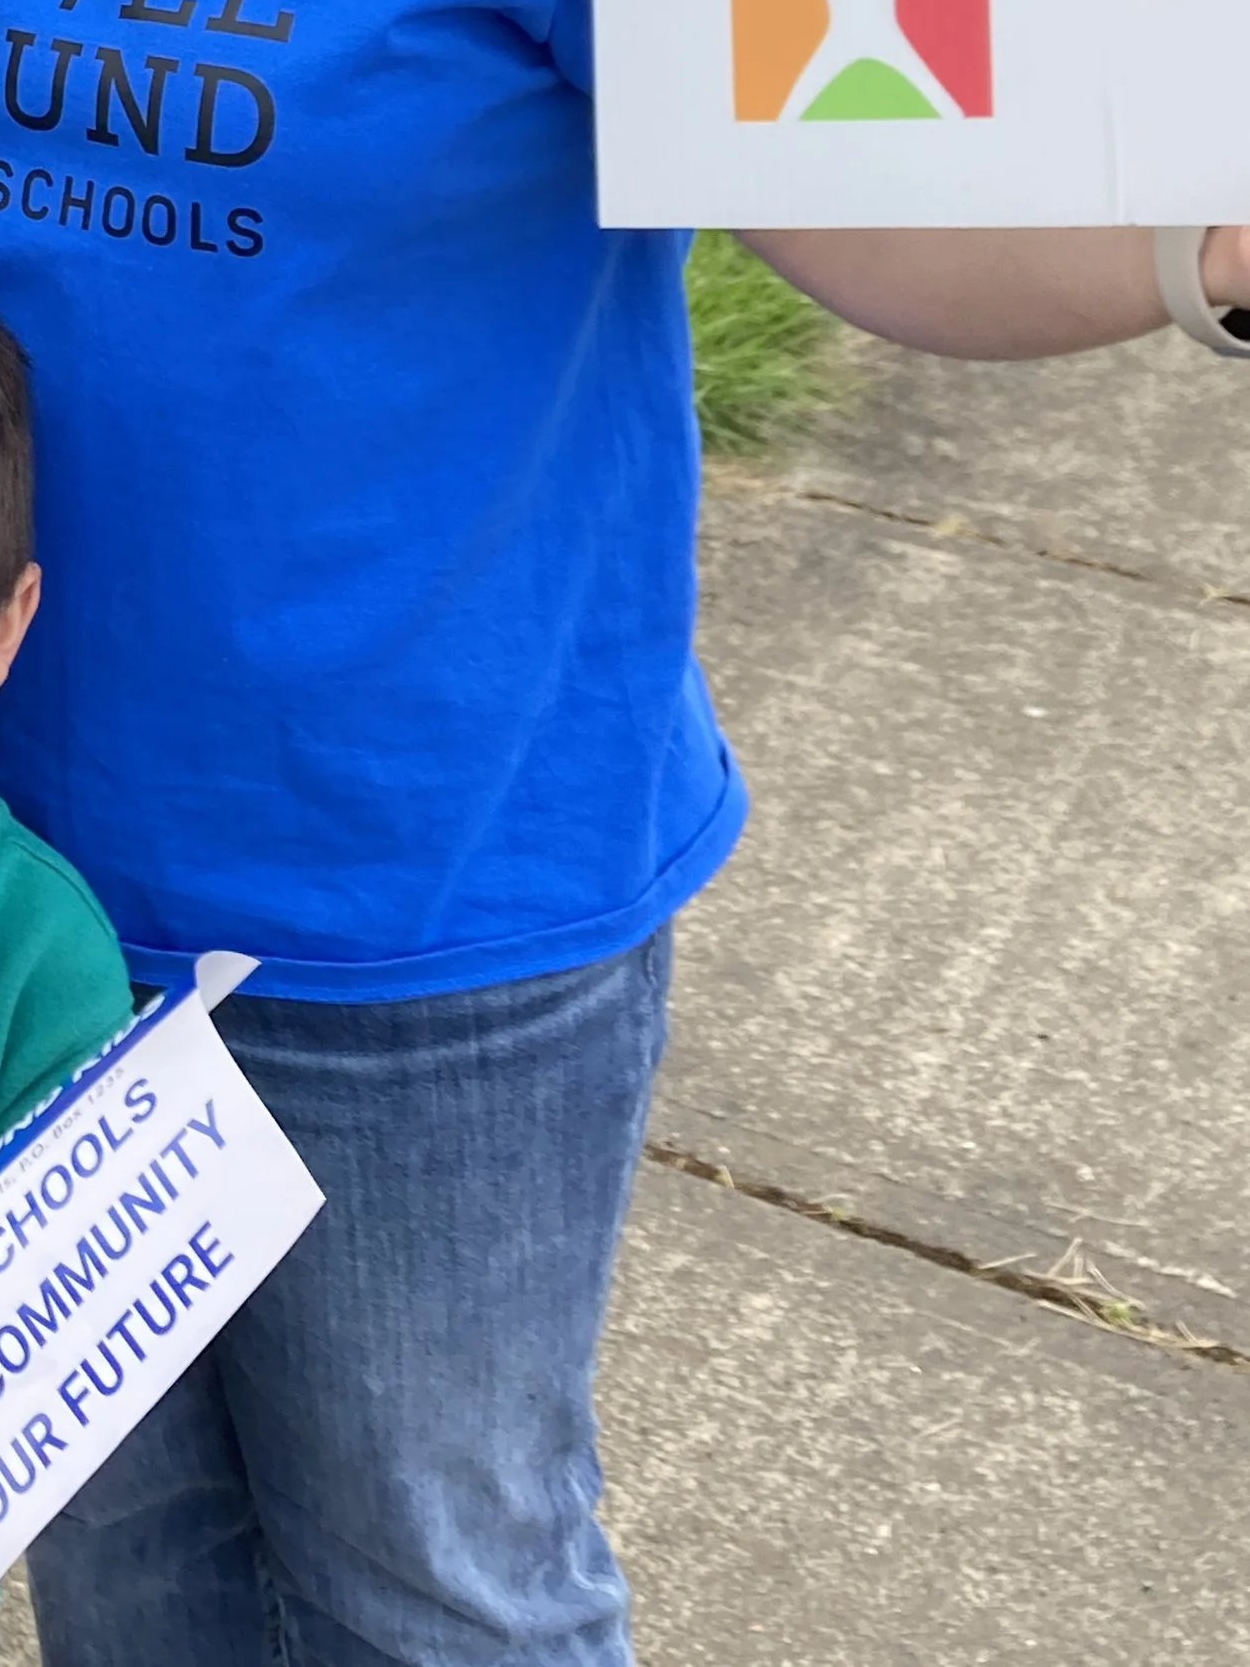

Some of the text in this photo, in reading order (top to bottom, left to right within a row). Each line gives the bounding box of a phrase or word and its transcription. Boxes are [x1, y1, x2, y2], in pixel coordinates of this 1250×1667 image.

[52, 1108, 83, 1140] Box
[87, 1066, 125, 1105] 1235
[56, 1221, 236, 1429] FUTURE
